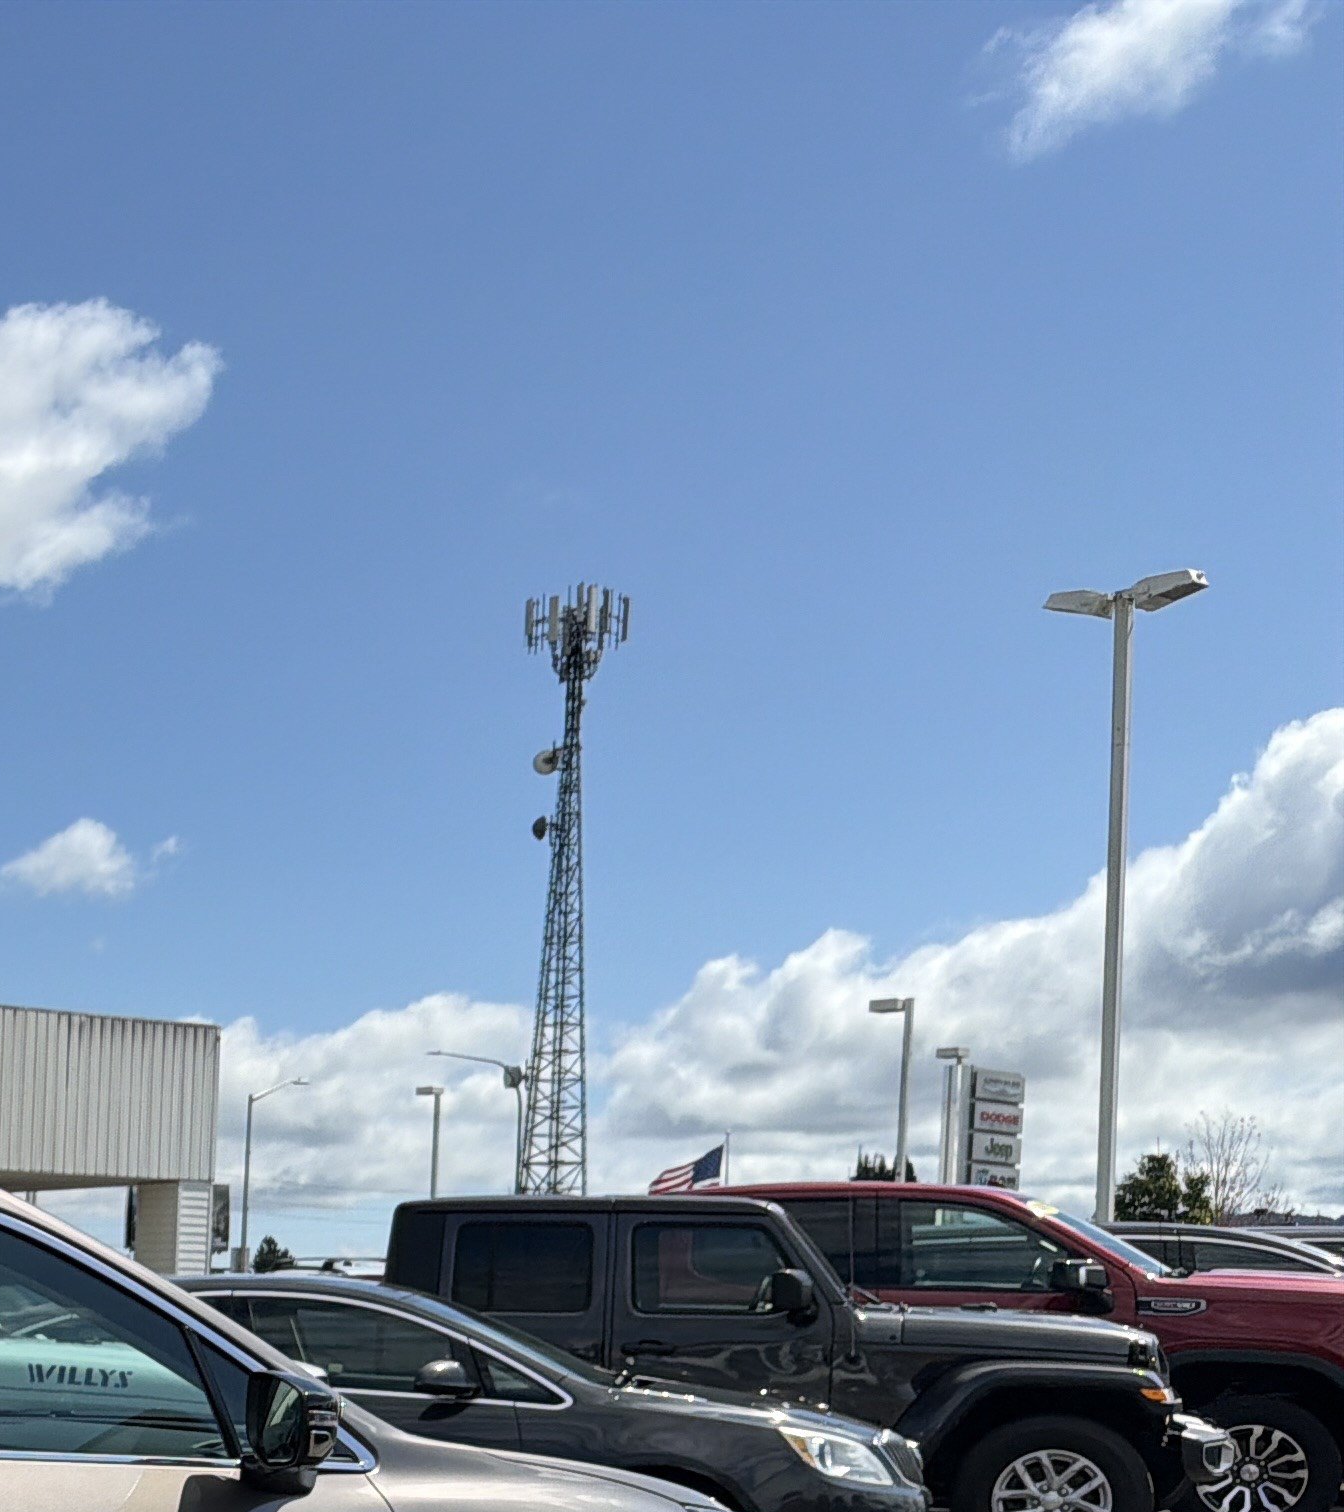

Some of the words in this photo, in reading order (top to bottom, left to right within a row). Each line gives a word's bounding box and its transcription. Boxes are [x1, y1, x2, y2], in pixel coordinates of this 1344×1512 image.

[980, 1111, 1020, 1126] DODGE
[984, 1138, 1013, 1160] Jeep
[28, 1363, 133, 1388] WILLYS
